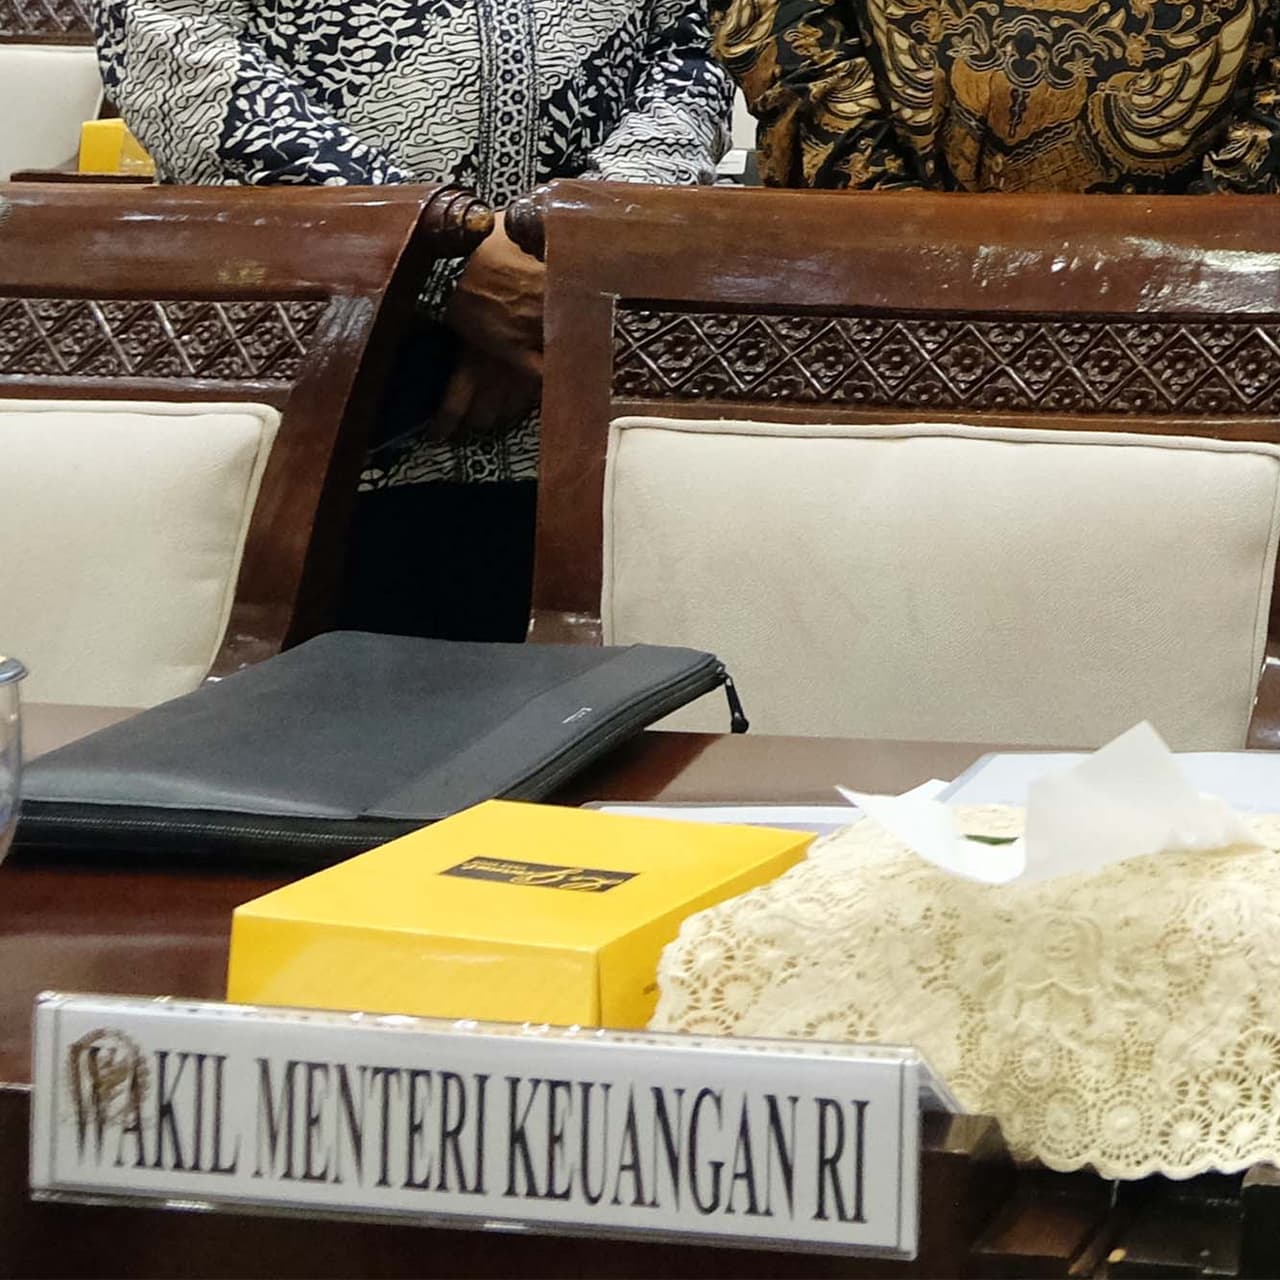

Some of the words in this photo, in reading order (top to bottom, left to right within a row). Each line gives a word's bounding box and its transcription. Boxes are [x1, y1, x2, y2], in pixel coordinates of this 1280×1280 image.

[70, 1046, 238, 1175] WAKIL
[251, 1056, 490, 1196] MENTERI
[502, 1075, 801, 1220] KEUANGAN
[812, 1096, 871, 1224] RI
